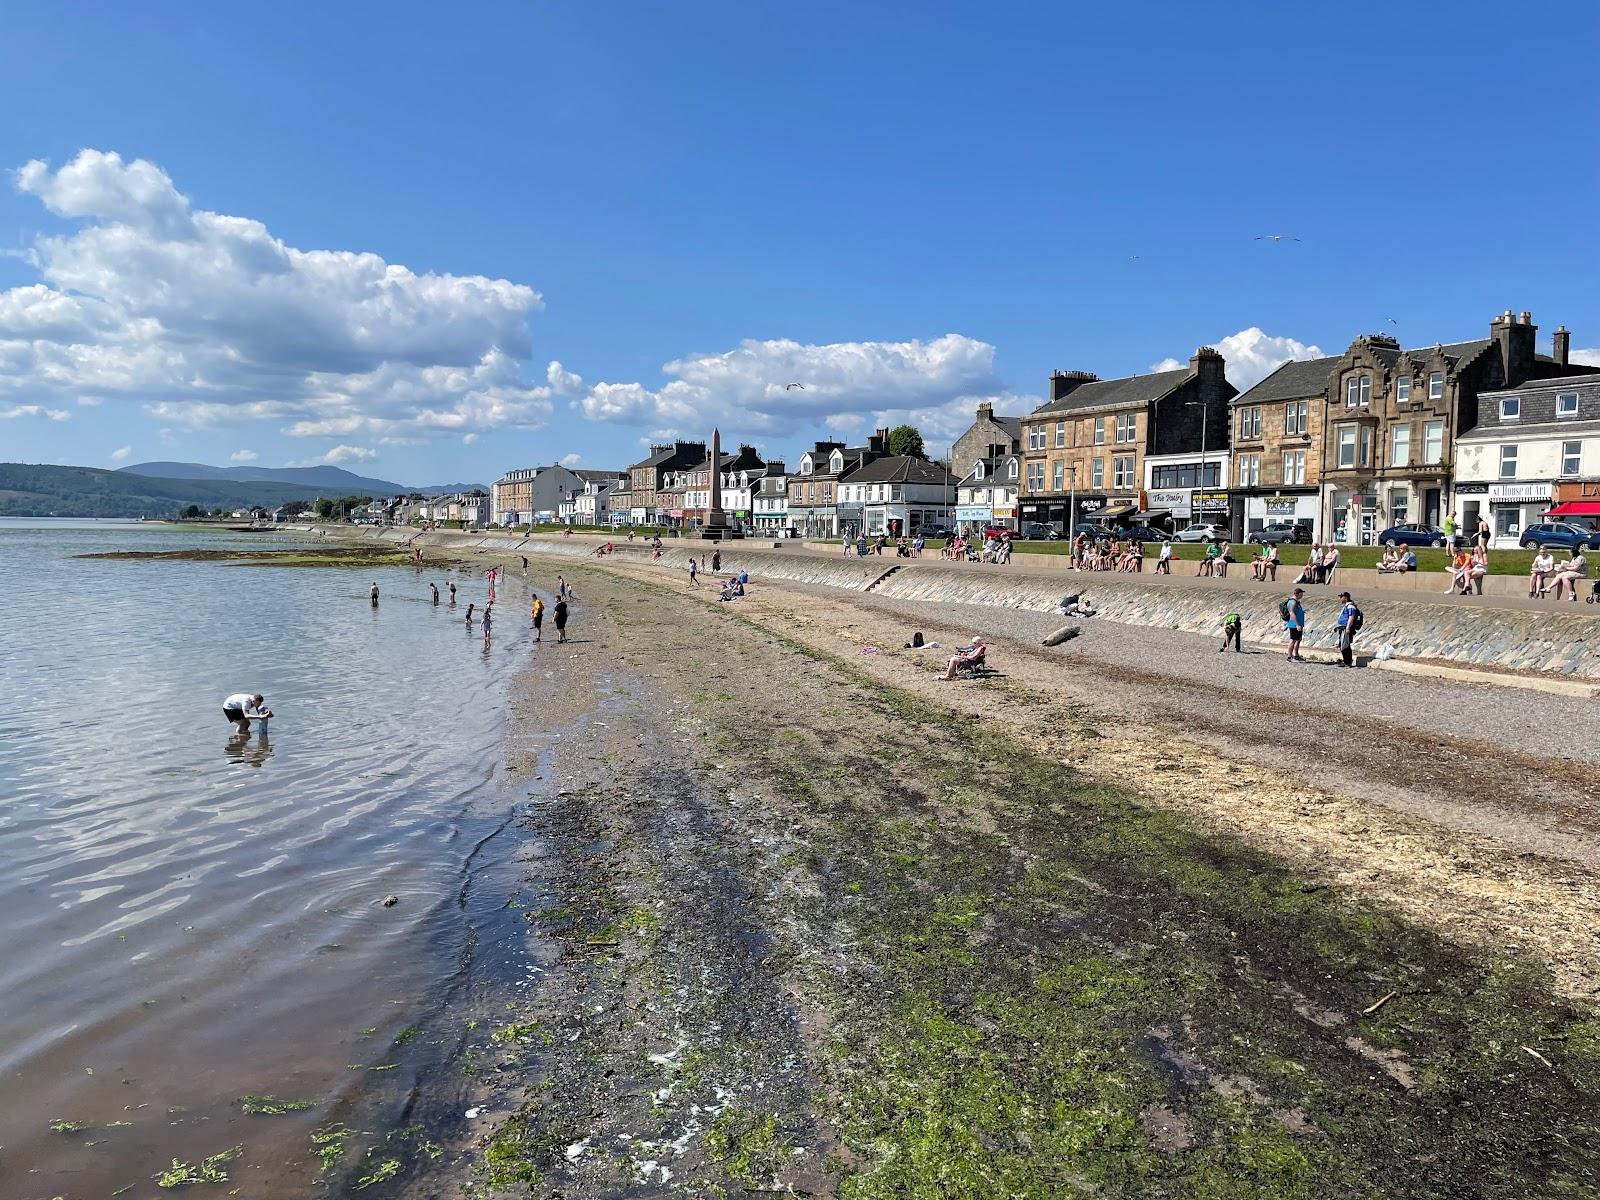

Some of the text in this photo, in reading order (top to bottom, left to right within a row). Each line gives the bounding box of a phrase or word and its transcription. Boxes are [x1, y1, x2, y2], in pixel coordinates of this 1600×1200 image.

[1502, 485, 1523, 496] House
[1525, 484, 1533, 496] of
[1535, 485, 1546, 496] Art
[1153, 493, 1165, 502] The
